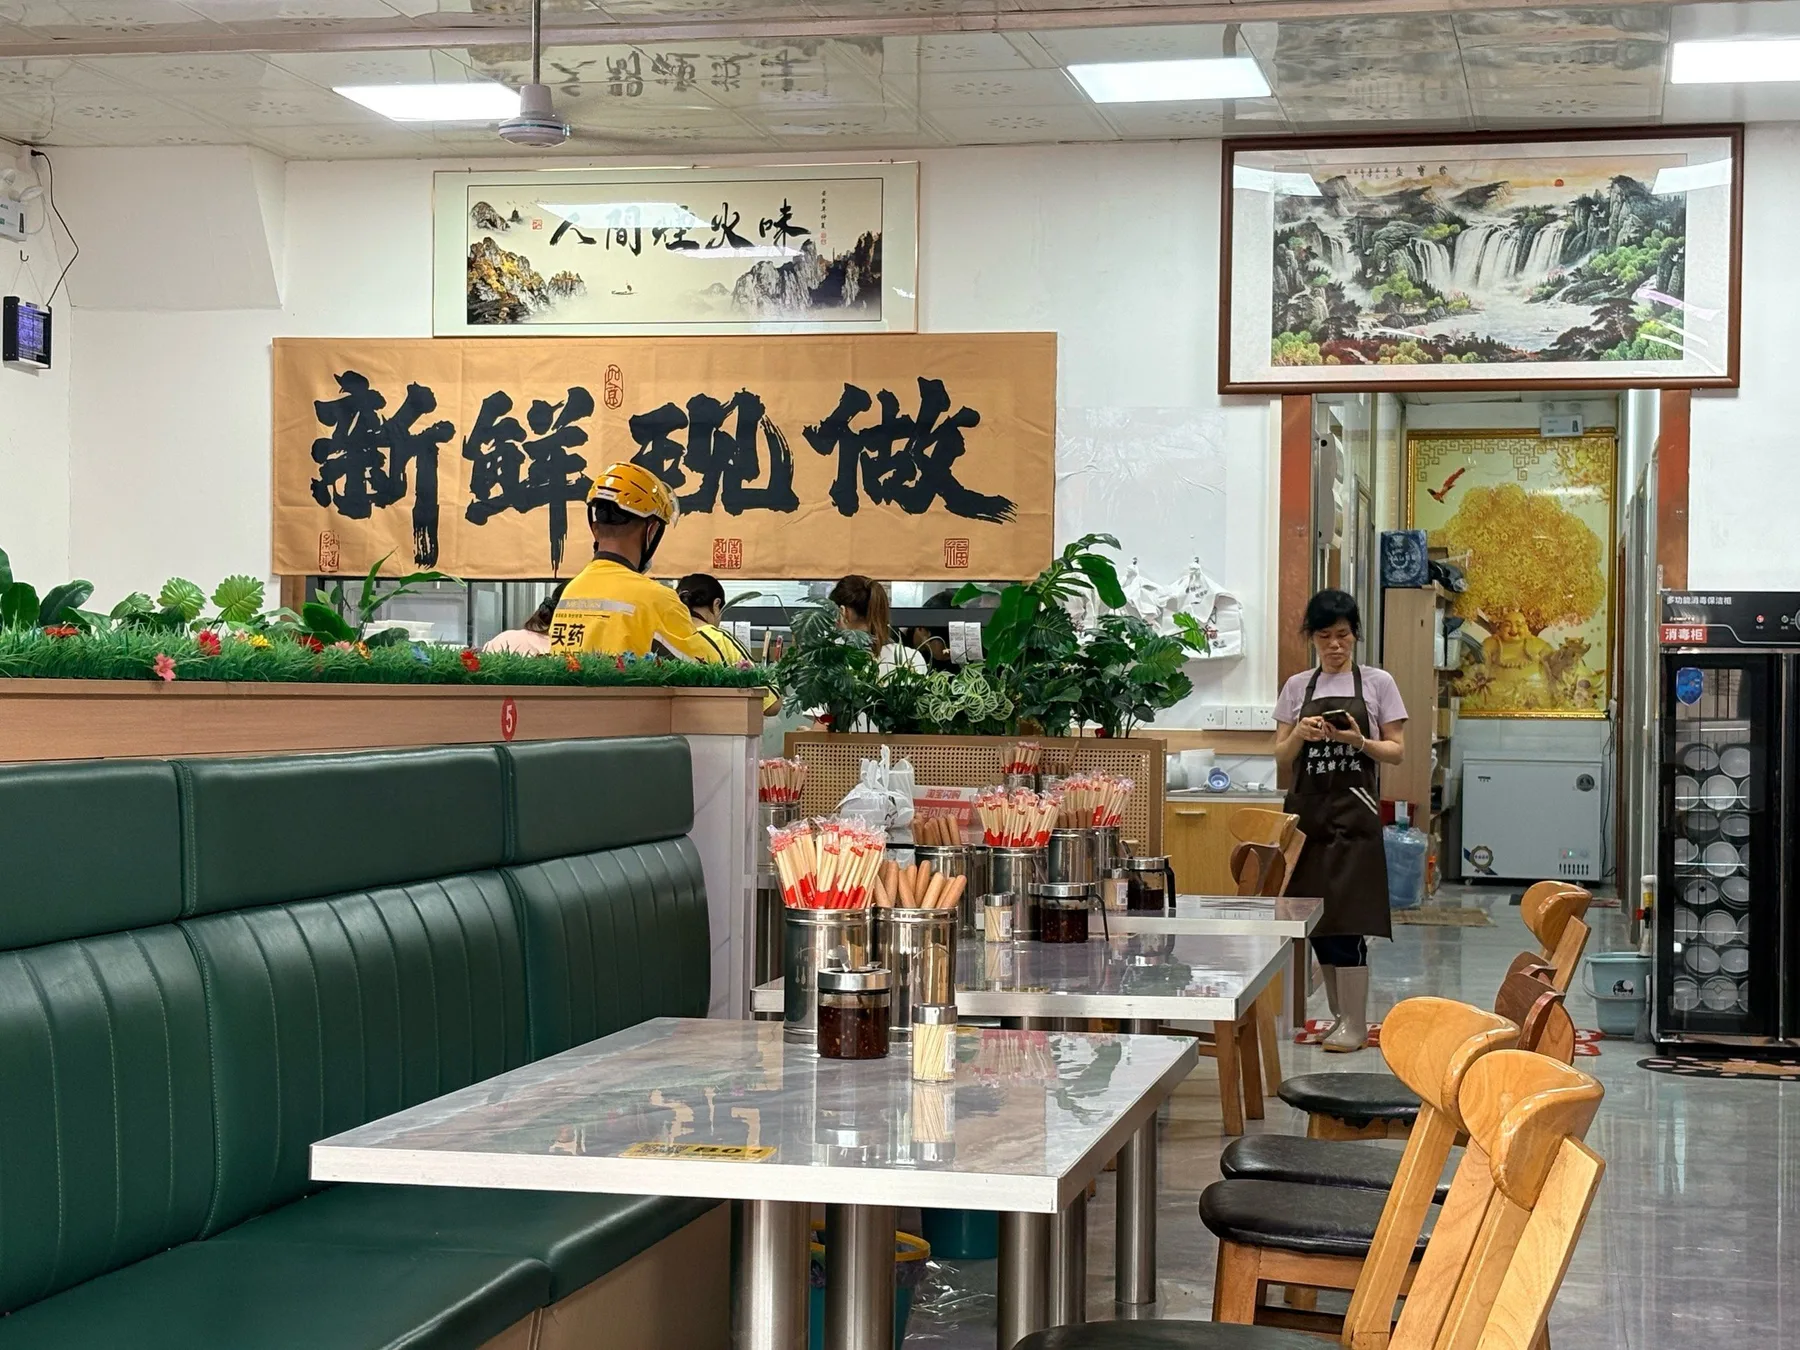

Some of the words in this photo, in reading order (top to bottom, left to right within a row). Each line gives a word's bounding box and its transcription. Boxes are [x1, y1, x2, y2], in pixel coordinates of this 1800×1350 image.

[551, 623, 586, 648] 买药
[1665, 628, 1704, 641] 消毒柜
[505, 704, 513, 733] 5
